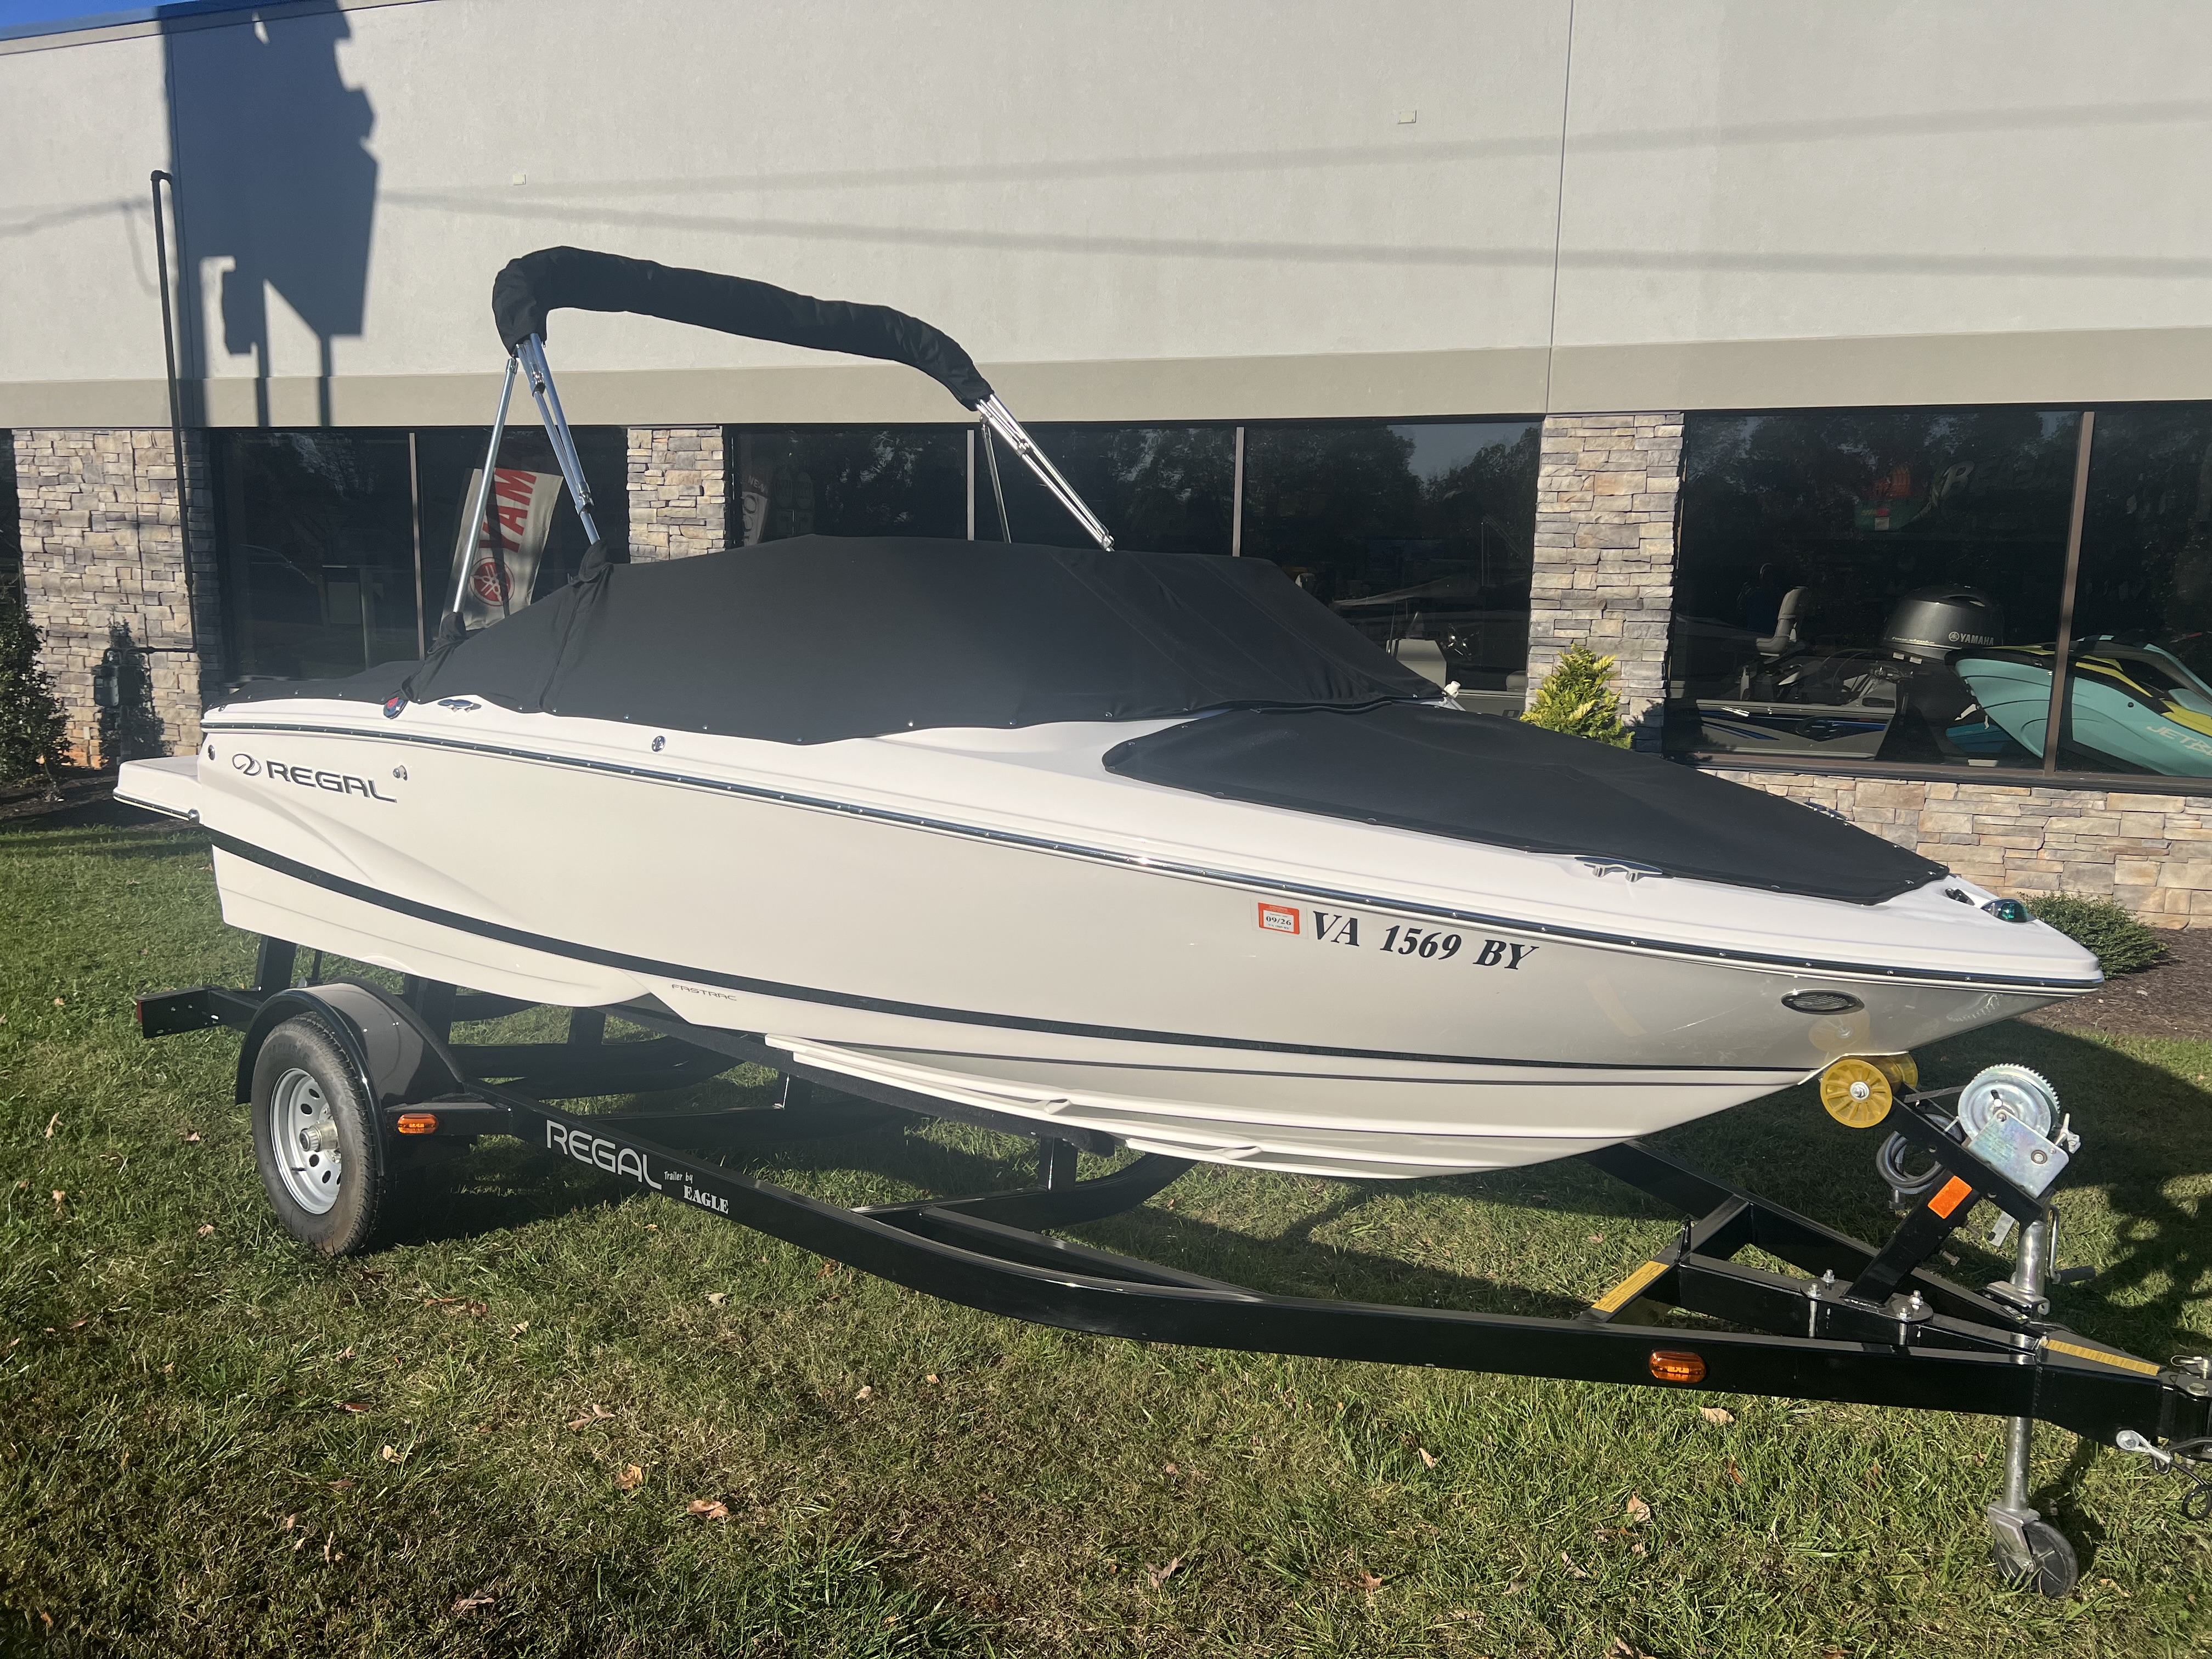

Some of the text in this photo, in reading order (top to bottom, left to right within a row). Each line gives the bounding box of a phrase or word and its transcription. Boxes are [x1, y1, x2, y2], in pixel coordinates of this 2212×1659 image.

[1960, 633, 1994, 646] YAMAHA
[266, 759, 398, 803] REGAL
[1266, 916, 1291, 926] 09/26
[1313, 911, 1540, 970] VA 1569 BY
[672, 984, 737, 1001] FASTRAC
[546, 1119, 662, 1190] REGAL
[664, 1171, 693, 1184] Trailer by
[683, 1185, 729, 1215] EAGLE
